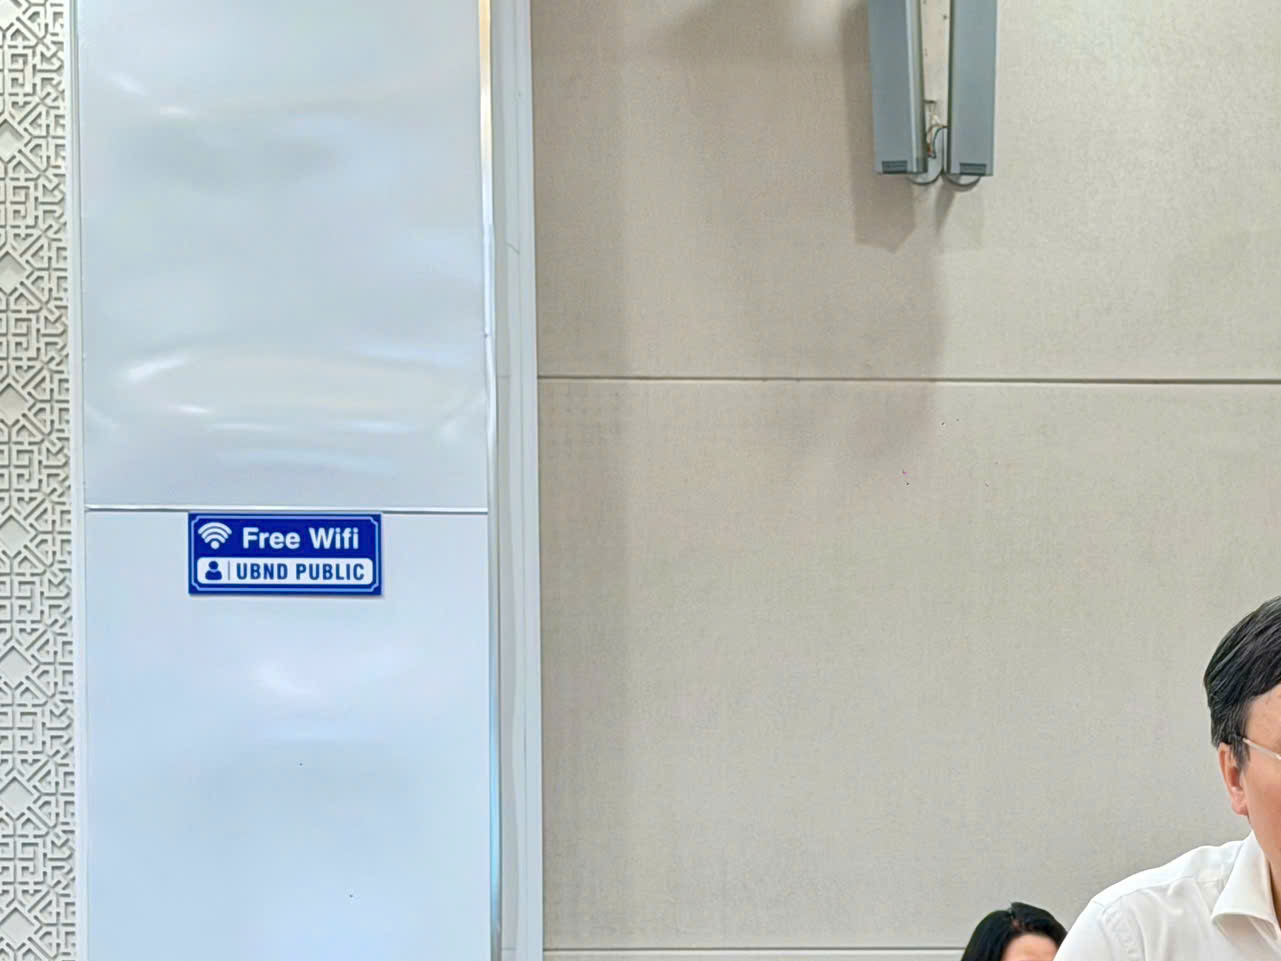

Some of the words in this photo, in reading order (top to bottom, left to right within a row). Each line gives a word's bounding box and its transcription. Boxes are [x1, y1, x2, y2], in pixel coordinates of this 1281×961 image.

[242, 526, 301, 550] Free
[308, 526, 360, 550] Wifi
[236, 562, 289, 581] UBND
[295, 562, 366, 581] PUBLIC
